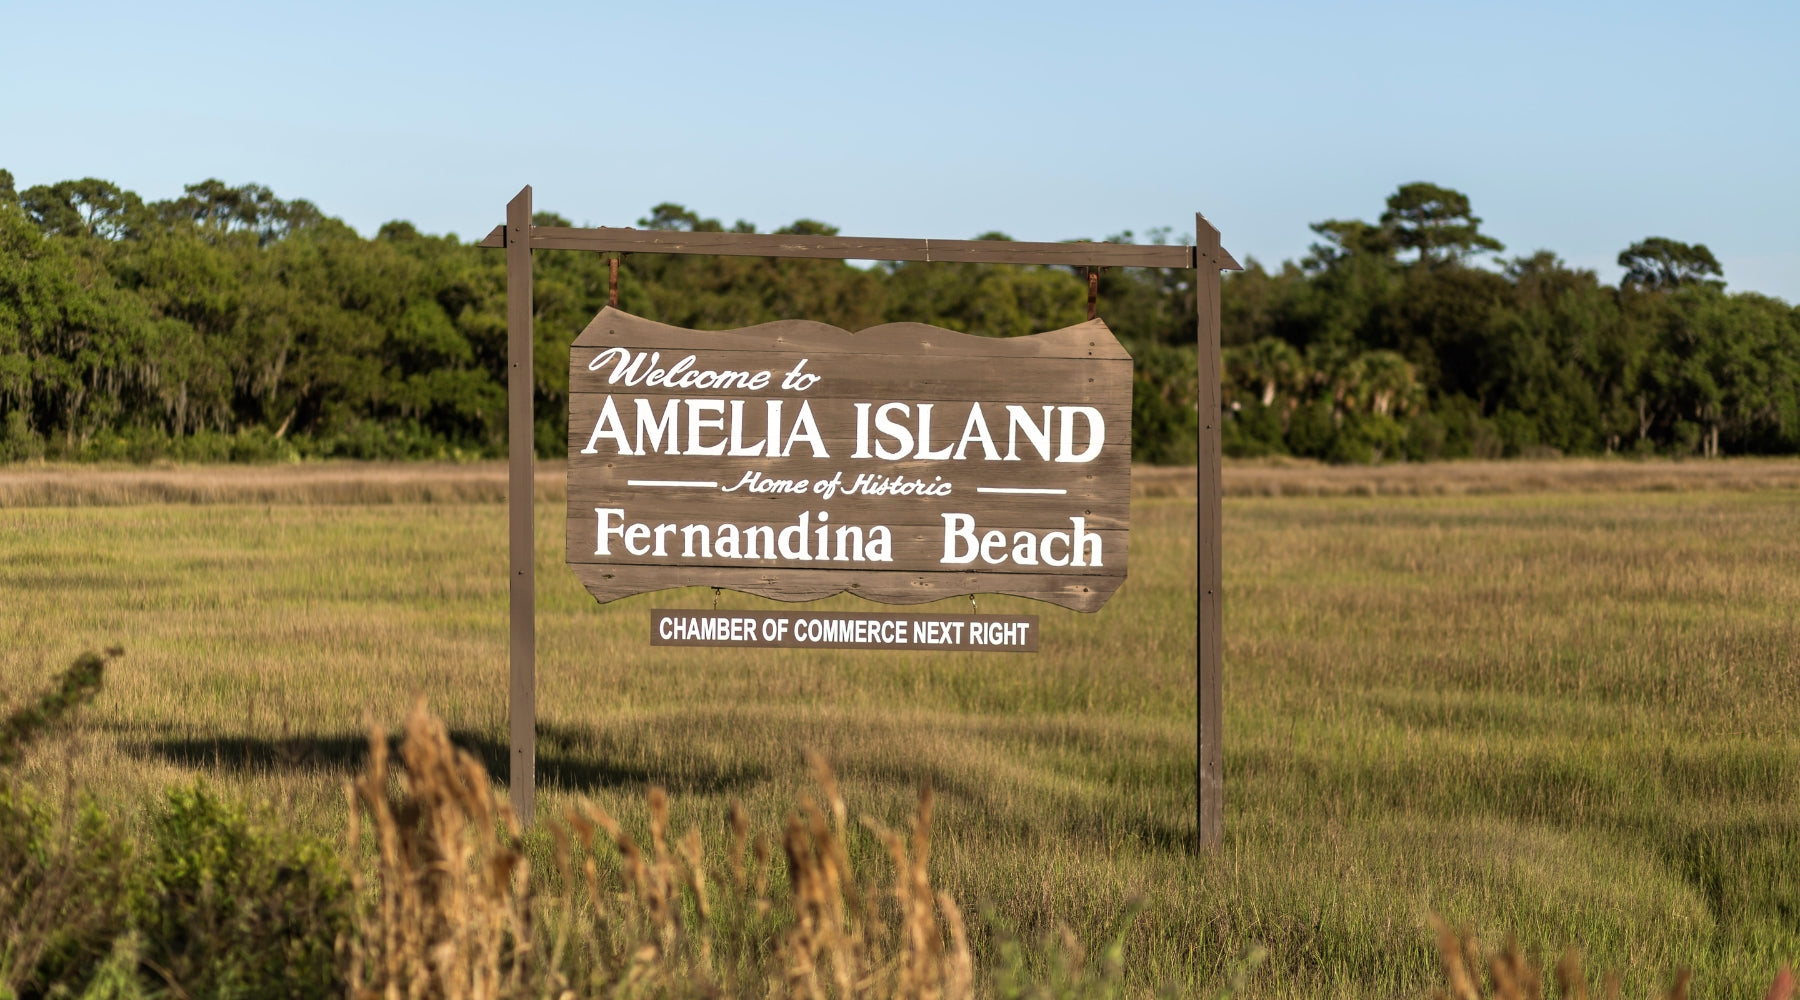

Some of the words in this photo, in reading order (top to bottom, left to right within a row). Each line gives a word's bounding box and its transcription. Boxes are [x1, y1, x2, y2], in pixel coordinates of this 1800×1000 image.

[588, 347, 771, 391] Welcome
[781, 358, 822, 392] to
[580, 394, 831, 459] AMELIA
[850, 401, 1106, 464] ISLAND
[721, 470, 809, 494] Home
[812, 471, 843, 501] of
[841, 473, 953, 498] Historic
[593, 507, 893, 563] Fernandina
[939, 512, 1104, 567] Beach
[659, 616, 758, 641] CHAMBER
[761, 618, 789, 642] OF
[793, 618, 908, 644] COMMERCE
[913, 620, 965, 645] NEXT
[969, 621, 1030, 646] RIGHT
